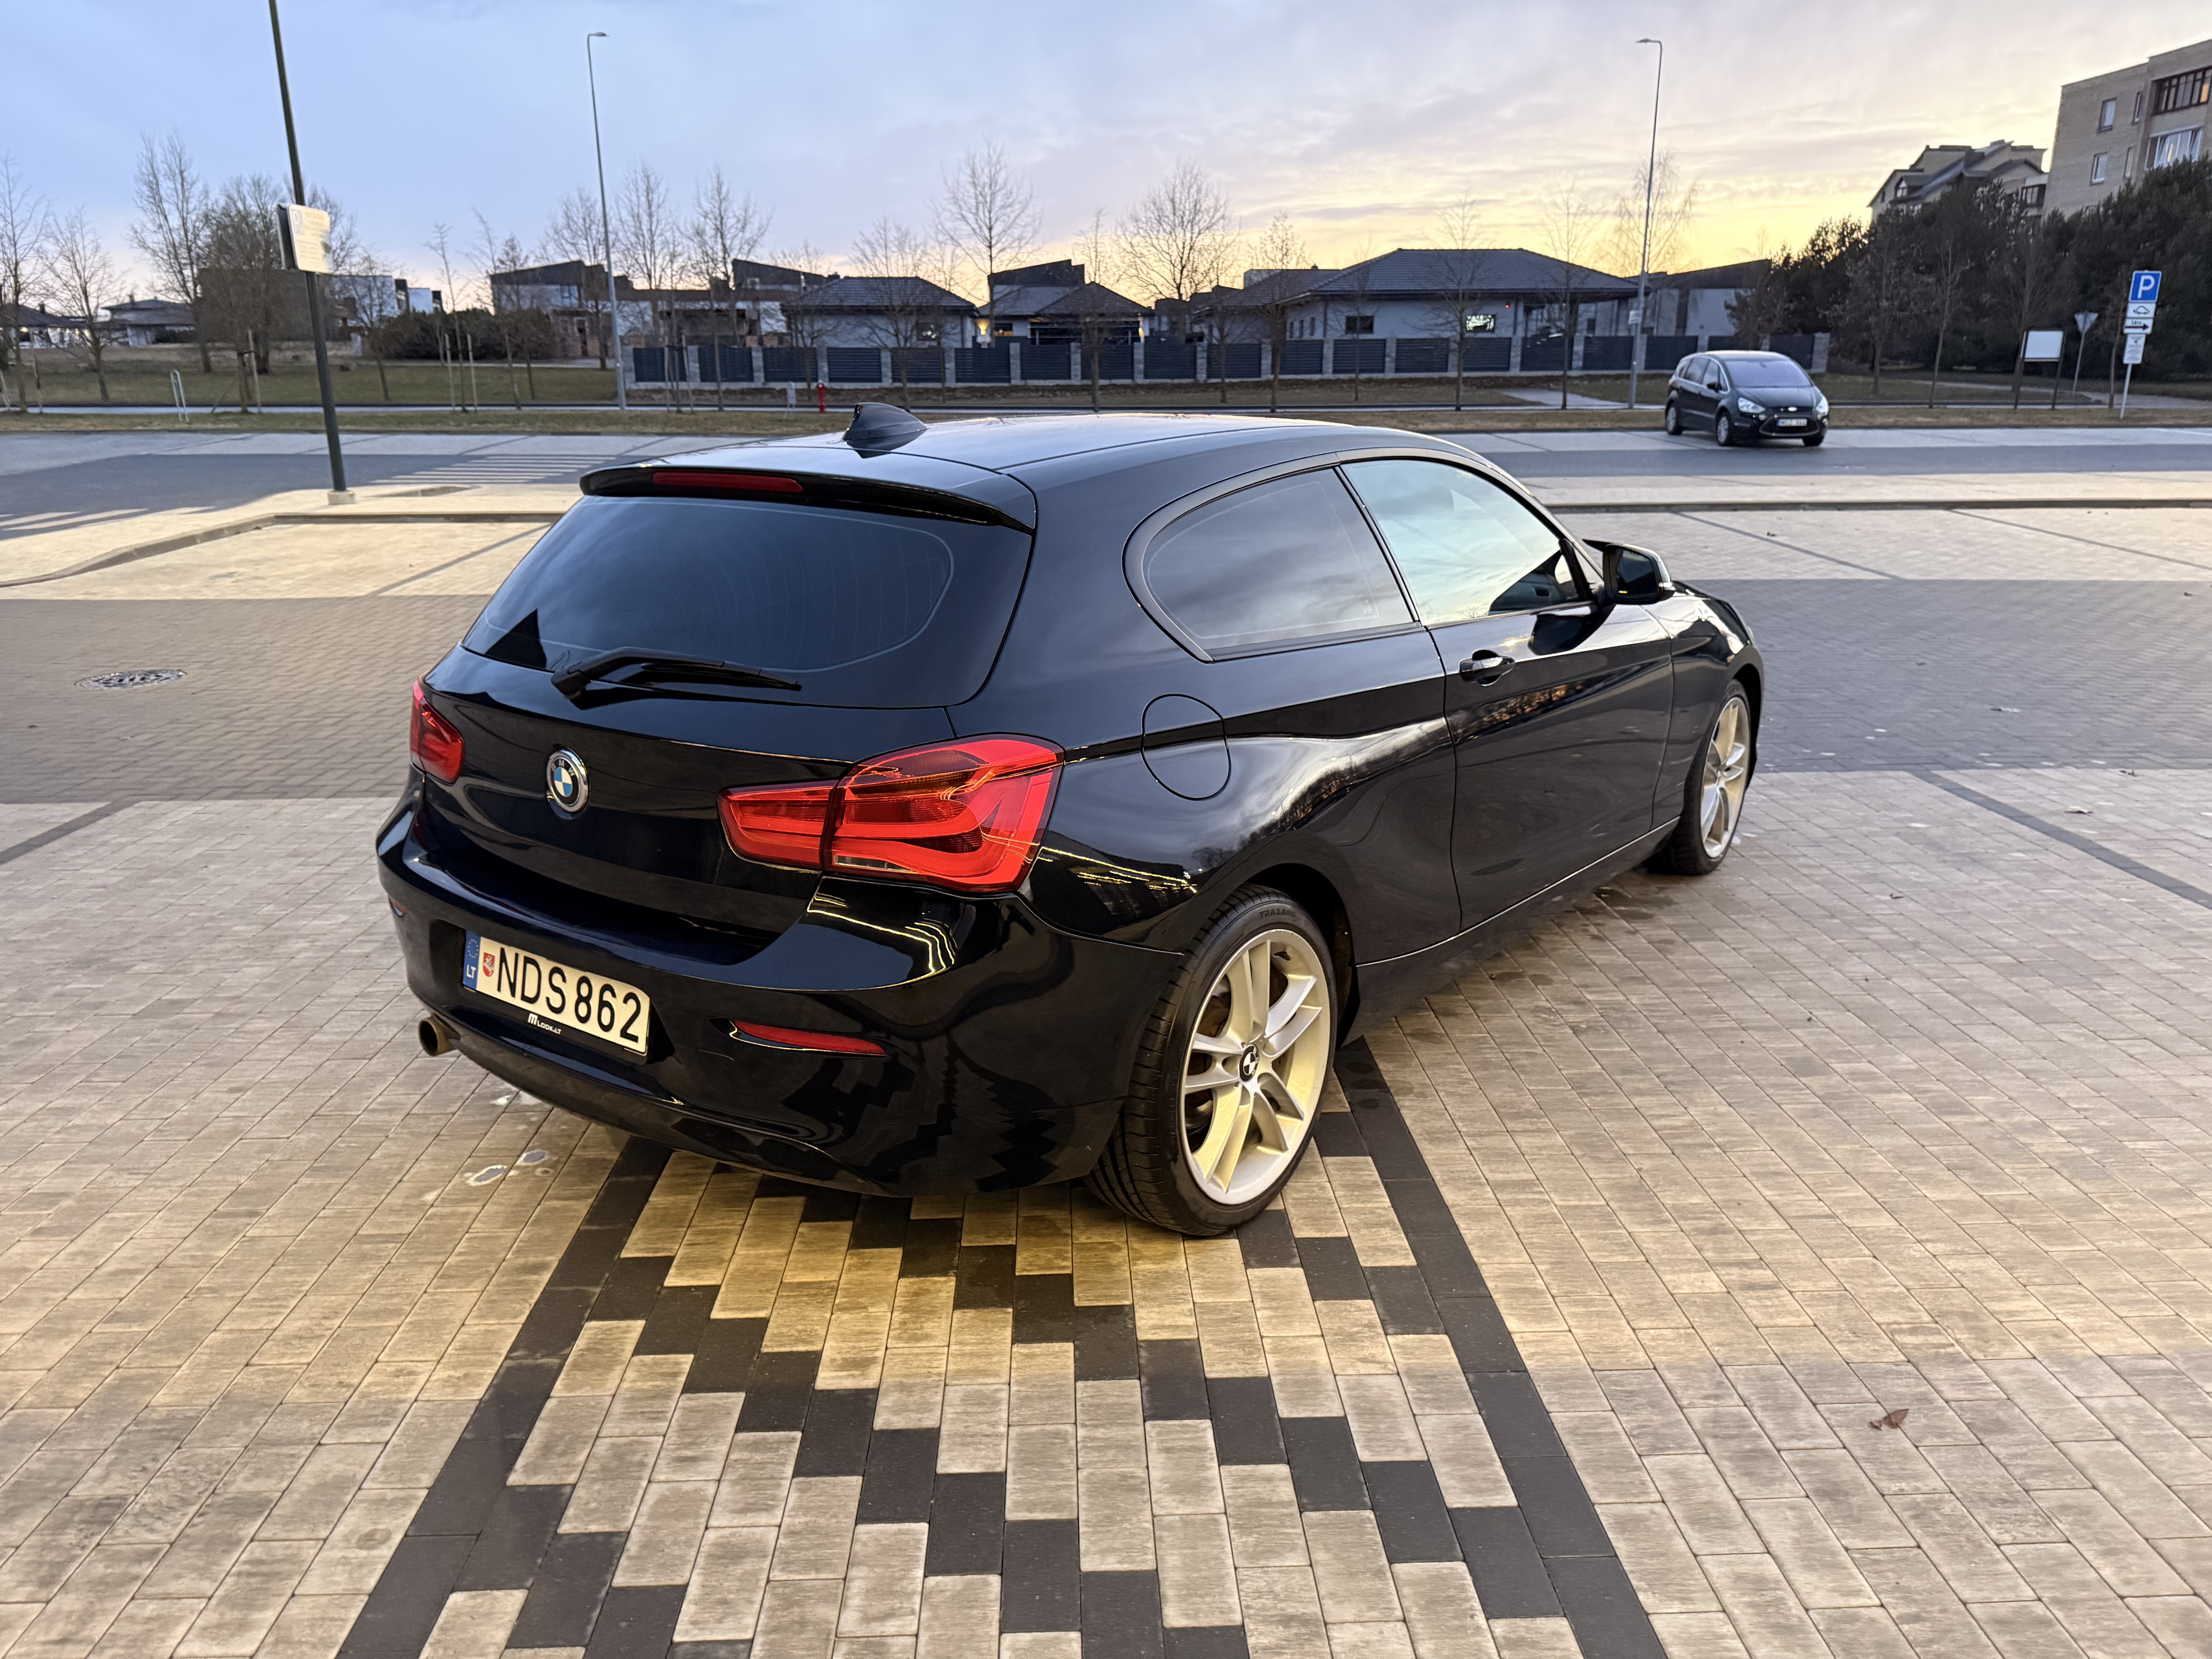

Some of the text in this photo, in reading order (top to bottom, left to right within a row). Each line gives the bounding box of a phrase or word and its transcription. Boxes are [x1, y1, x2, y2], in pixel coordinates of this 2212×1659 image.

[2138, 275, 2155, 299] P
[551, 759, 575, 776] BMW
[467, 964, 476, 979] LT
